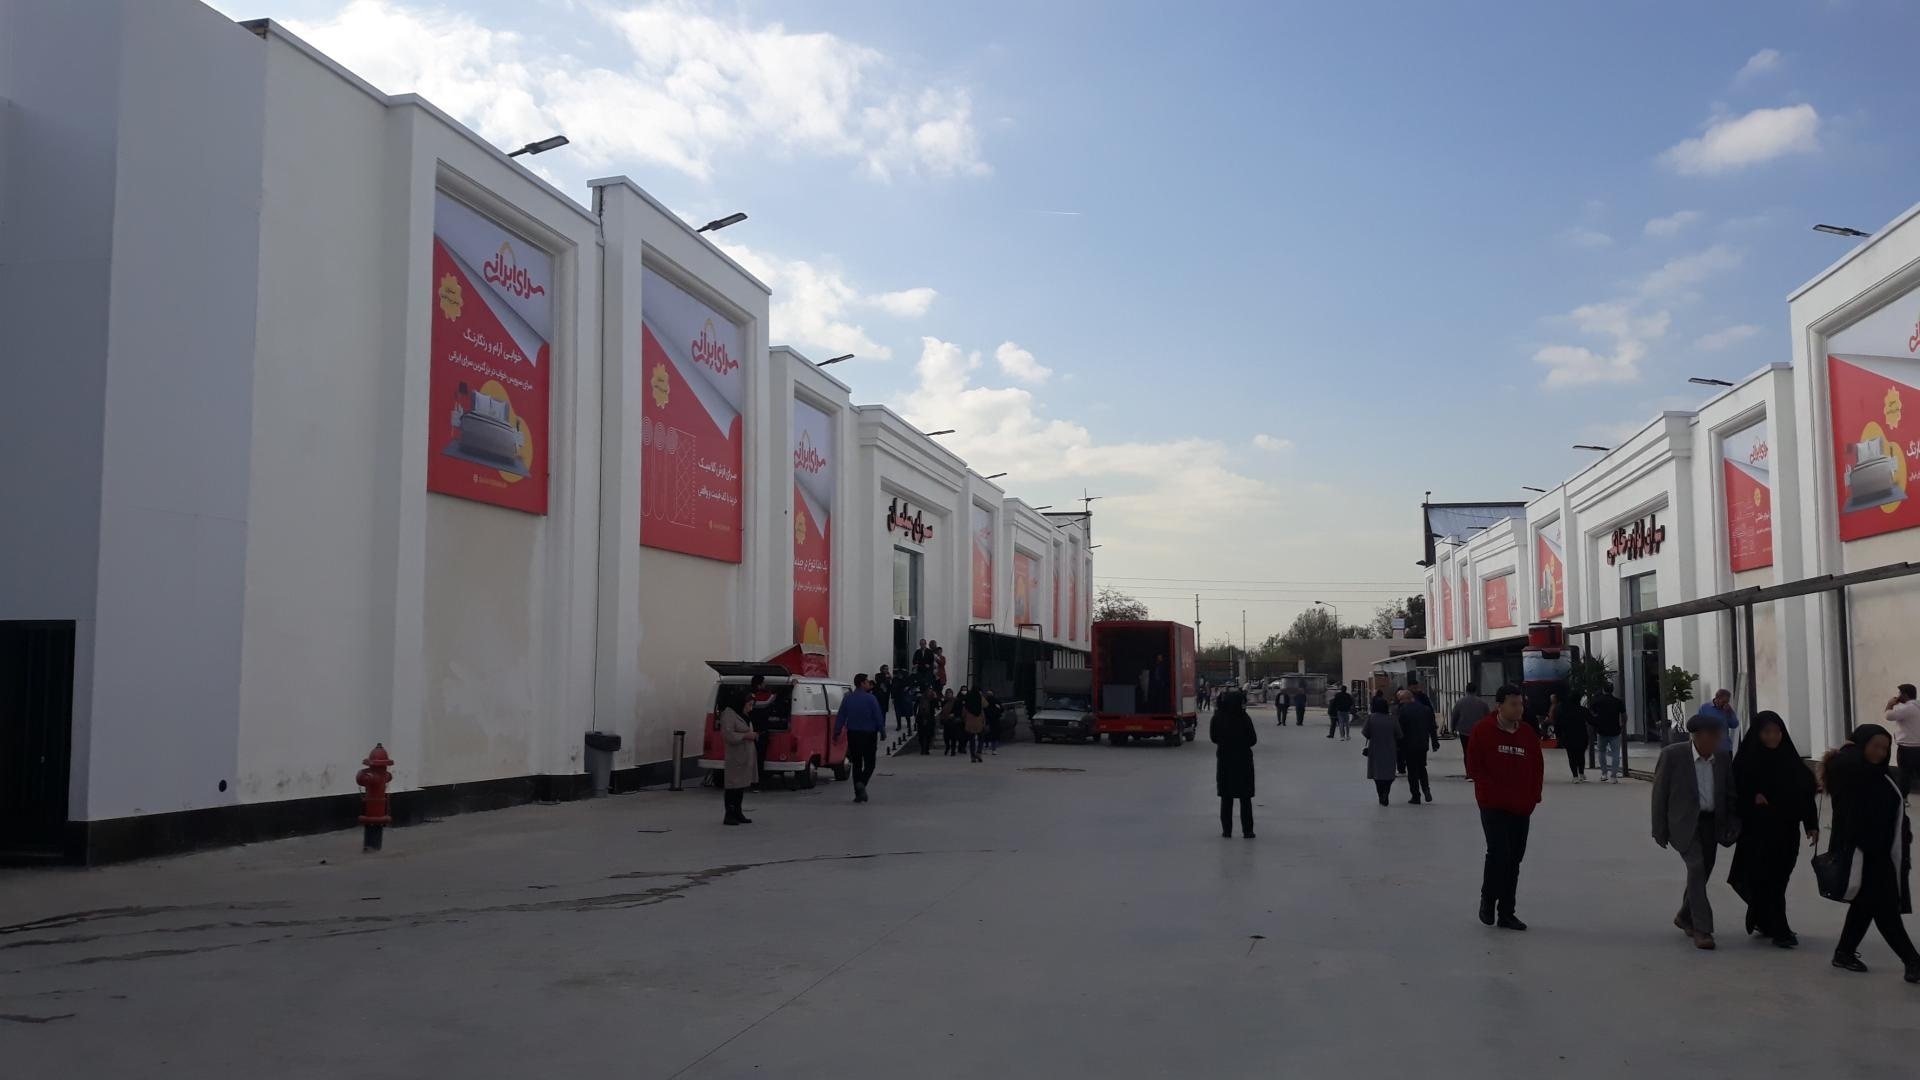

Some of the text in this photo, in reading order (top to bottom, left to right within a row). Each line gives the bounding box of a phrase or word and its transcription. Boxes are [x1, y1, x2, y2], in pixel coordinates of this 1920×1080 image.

[483, 252, 545, 300] سرای ایرانی
[492, 341, 503, 357] آرام
[691, 330, 739, 376] سرای ایرانی
[886, 496, 933, 543] سرای مبلمان
